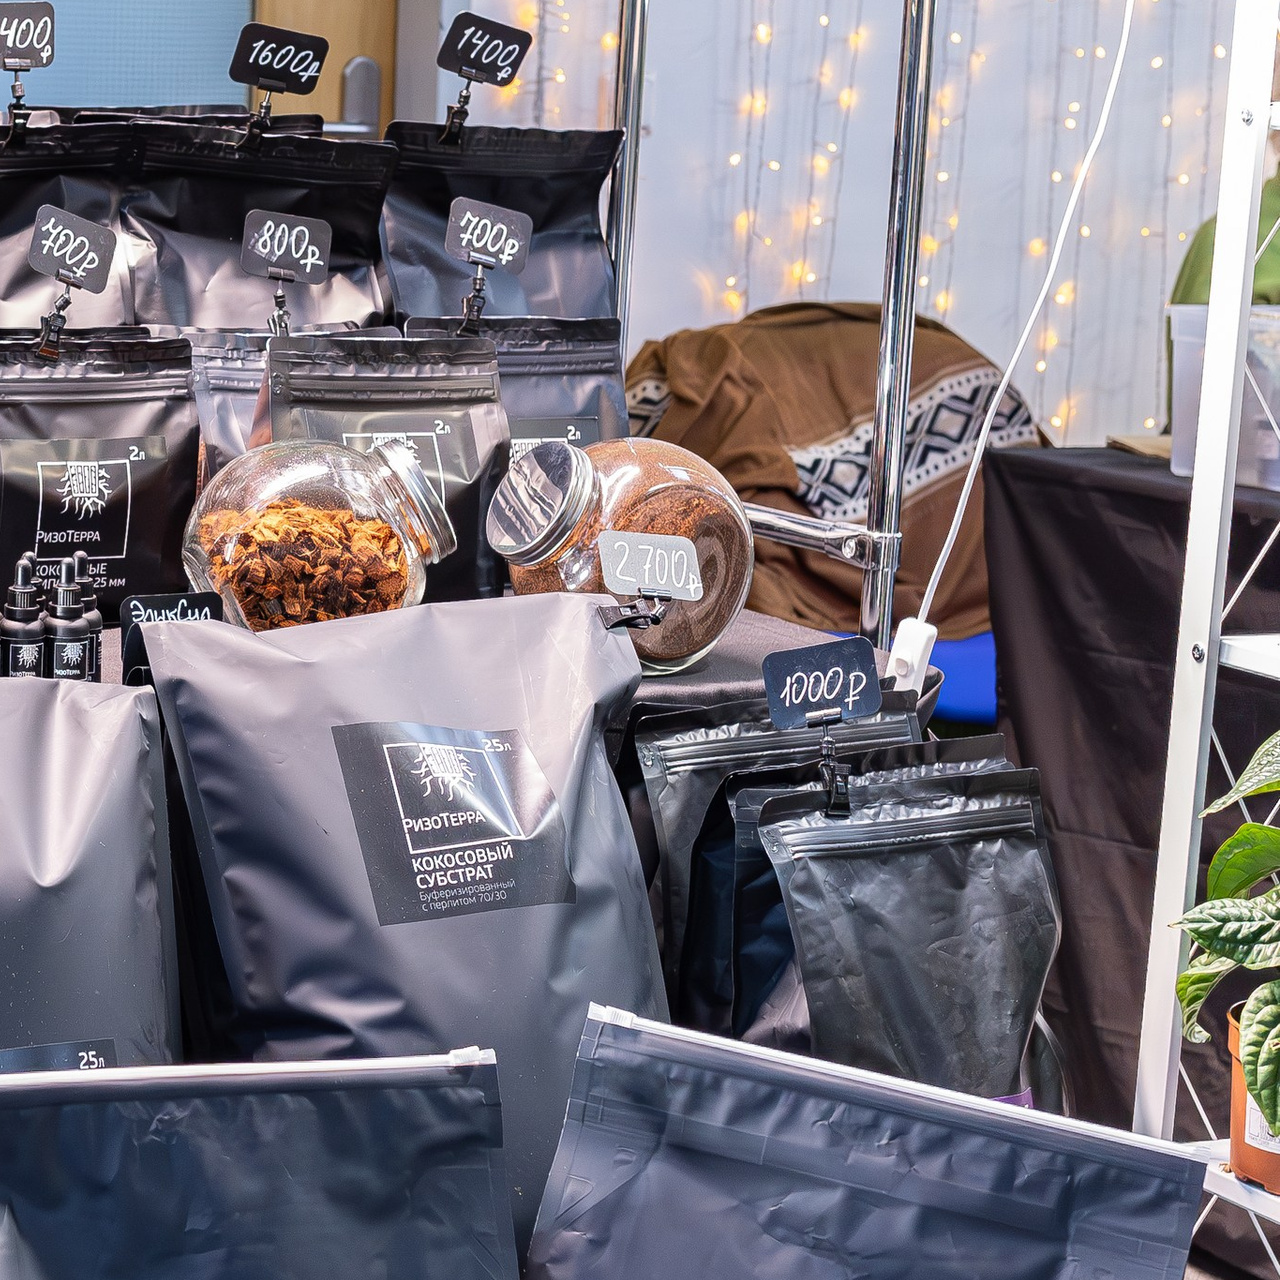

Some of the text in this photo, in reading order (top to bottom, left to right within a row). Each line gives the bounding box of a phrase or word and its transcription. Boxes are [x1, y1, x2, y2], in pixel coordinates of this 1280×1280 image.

[433, 420, 452, 435] 2л
[567, 426, 582, 440] 2л
[128, 445, 146, 461] 2л
[481, 738, 512, 753] 25л
[411, 841, 514, 873] КОКОСОВЫЙ
[415, 864, 495, 889] СУБСТРАТ
[419, 878, 517, 902] Буферизированный
[429, 896, 477, 912] перлитом
[478, 890, 508, 907] 70/30
[77, 1050, 106, 1070] 25л
